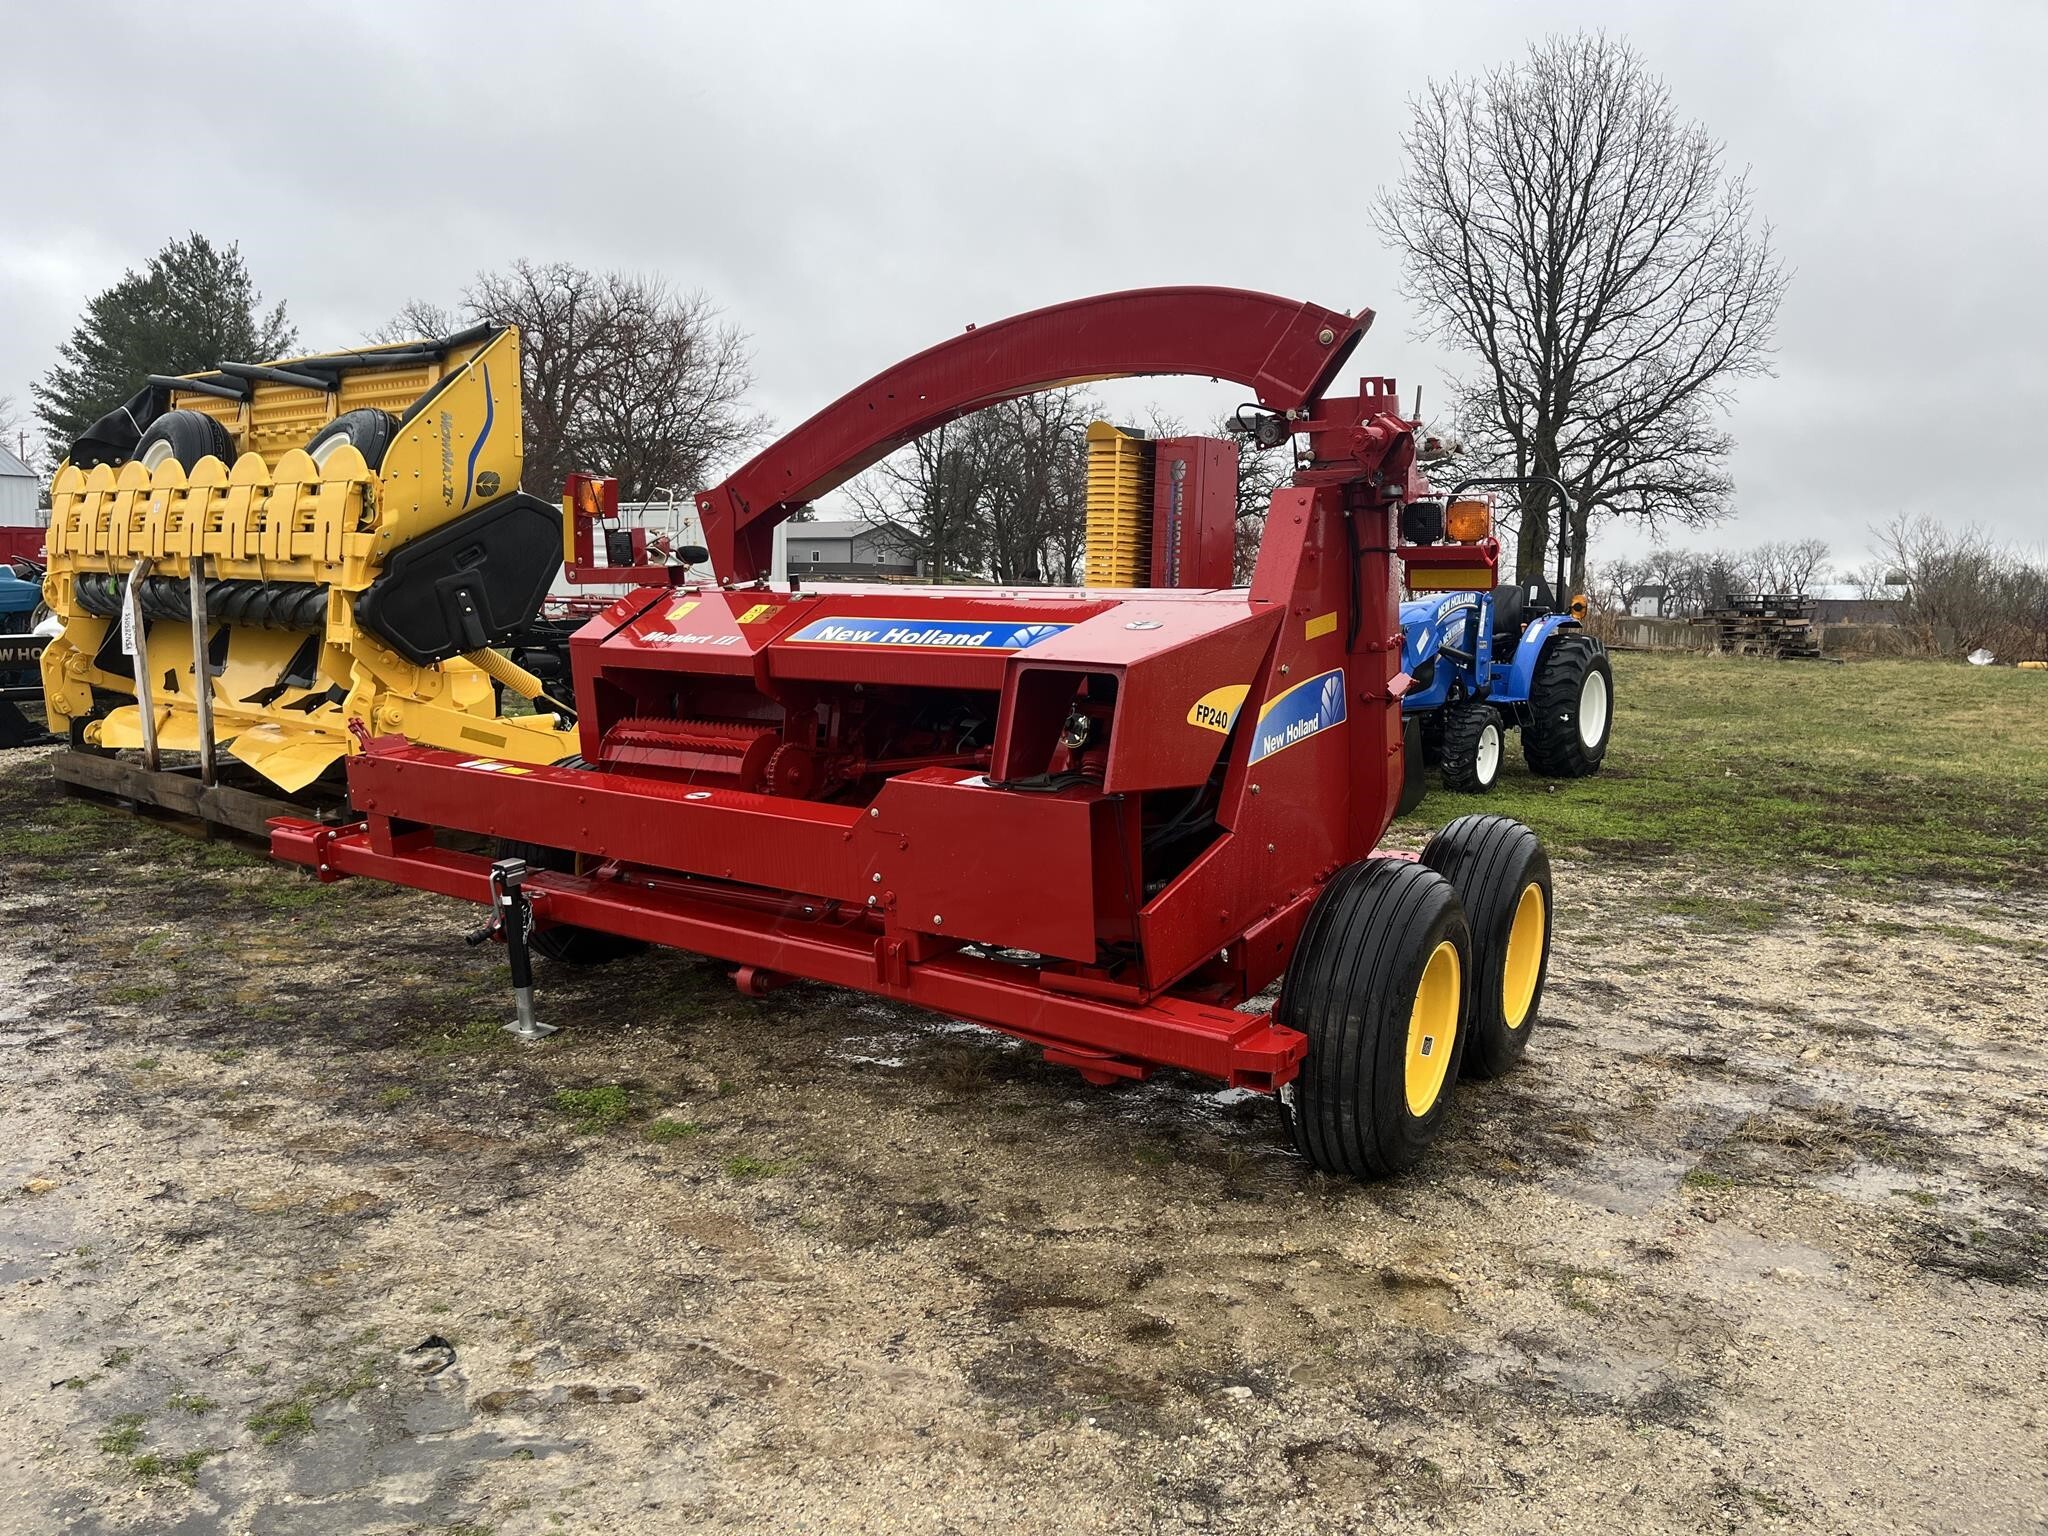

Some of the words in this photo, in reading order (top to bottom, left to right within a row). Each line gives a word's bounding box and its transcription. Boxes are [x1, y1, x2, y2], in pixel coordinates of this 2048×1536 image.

[1173, 481, 1184, 516] NEW
[1171, 520, 1182, 587] HOLLAND
[1438, 599, 1451, 619] NEW
[1451, 593, 1476, 608] HOLLAND
[640, 631, 714, 644] Metalert
[711, 635, 744, 646] III
[815, 625, 879, 643] New
[880, 627, 992, 647] Holland
[1196, 704, 1228, 729] FP240
[1263, 732, 1285, 755] New
[1286, 713, 1319, 743] Holland
